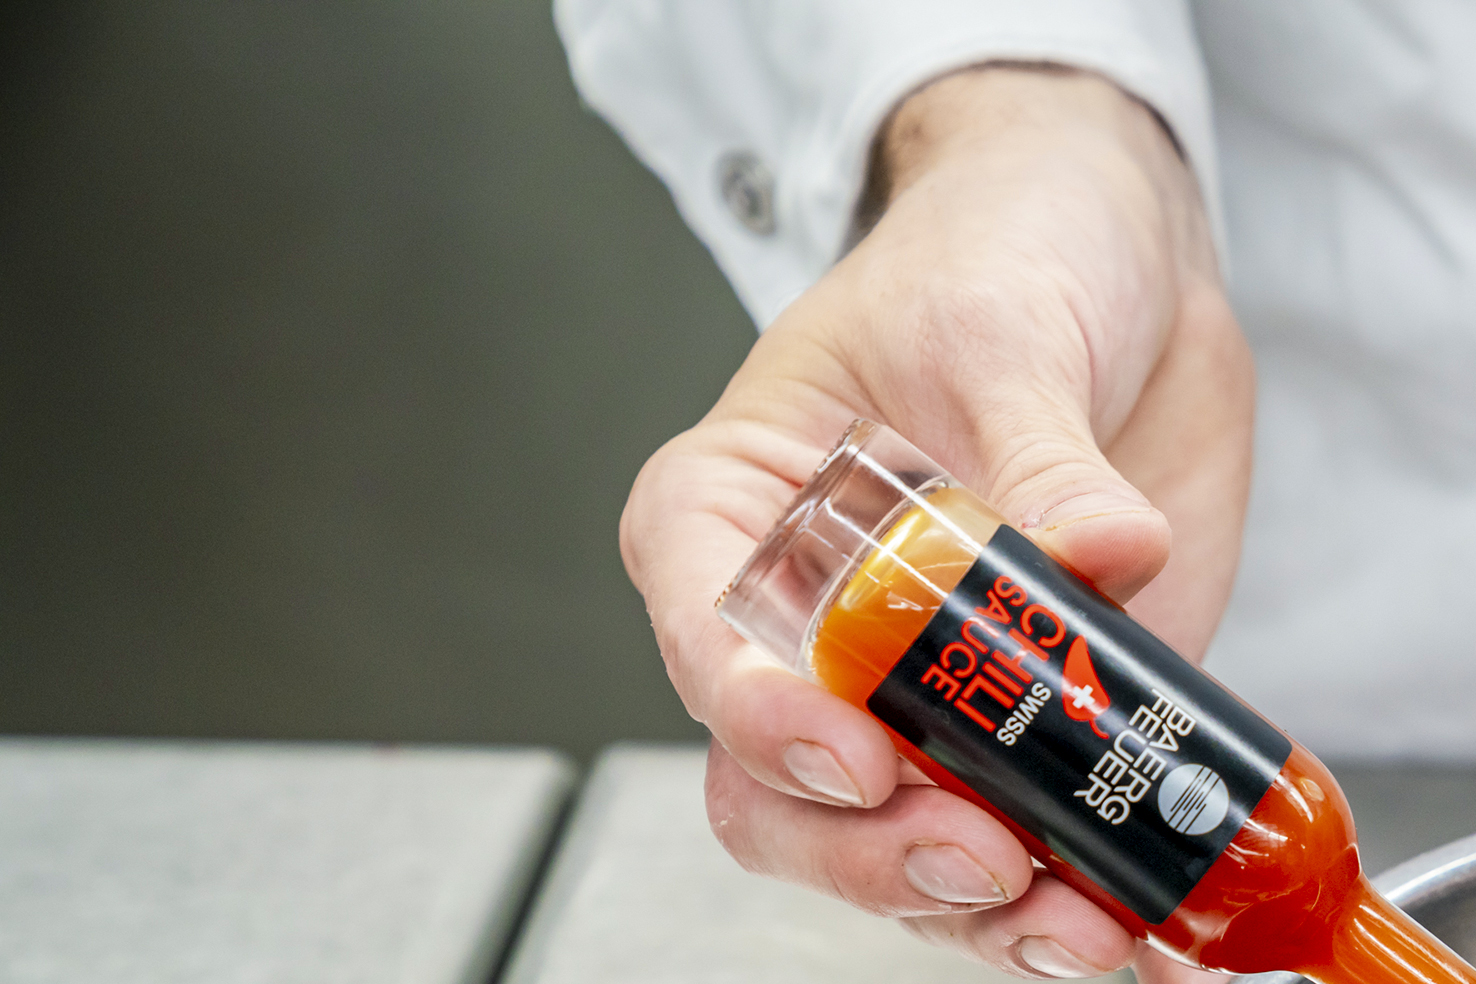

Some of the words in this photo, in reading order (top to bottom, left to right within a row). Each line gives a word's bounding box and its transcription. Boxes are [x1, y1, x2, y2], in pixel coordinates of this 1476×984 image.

[920, 575, 1028, 701] SAUCE
[953, 603, 1067, 733] CHILI
[996, 682, 1052, 746] SWISS
[1073, 688, 1174, 807] FEUER
[1096, 705, 1197, 825] BAERG
